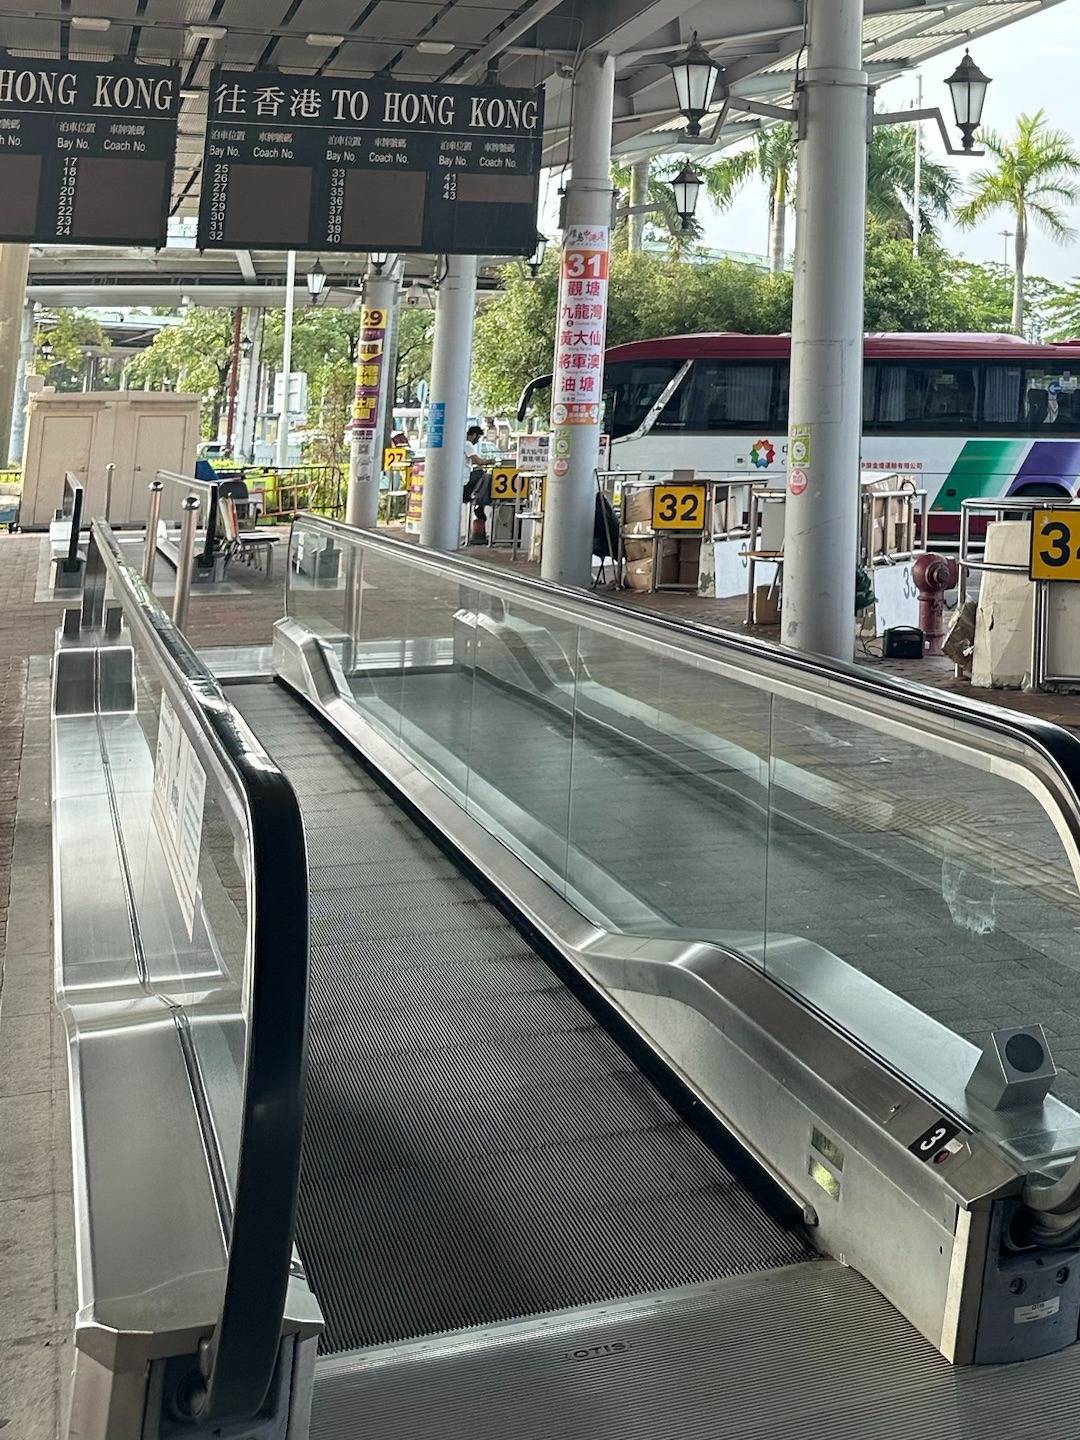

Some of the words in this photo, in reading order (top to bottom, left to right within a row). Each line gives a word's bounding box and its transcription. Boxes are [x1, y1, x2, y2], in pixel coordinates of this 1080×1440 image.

[0, 69, 77, 105] HONG
[93, 75, 173, 110] KONG
[214, 83, 322, 118] 往香港
[331, 89, 369, 121] TO
[382, 92, 455, 125] HONG
[469, 97, 539, 129] KONG
[8, 135, 22, 147] No.
[57, 137, 73, 150] Bay
[76, 138, 90, 149] No.
[104, 139, 130, 151] Coach
[133, 141, 147, 152] No.
[209, 145, 224, 158] Bay
[227, 146, 240, 157] No.
[253, 147, 279, 158] Coach
[281, 148, 295, 159] No.
[326, 150, 341, 163] Bay
[343, 151, 356, 162] No.
[368, 152, 393, 163] Coach
[396, 153, 409, 164] No.
[439, 155, 454, 167] Bay
[455, 155, 468, 166] No.
[64, 157, 78, 166] 17
[479, 157, 503, 168] Coach
[505, 158, 518, 168] No.
[63, 167, 77, 176] 18
[214, 164, 229, 173] 25
[214, 174, 228, 182] 26
[332, 169, 346, 178] 33
[443, 173, 456, 181] 41
[62, 177, 76, 186] 19
[331, 178, 344, 187] 34
[213, 183, 227, 192] 27
[443, 182, 457, 191] 42
[60, 187, 75, 196] 20
[330, 187, 344, 196] 35
[442, 191, 456, 200] 43
[59, 197, 73, 205] 21
[212, 193, 226, 201] 28
[330, 197, 343, 205] 36
[58, 207, 73, 215] 22
[211, 202, 226, 211] 29
[329, 206, 342, 215] 37
[57, 216, 72, 225] 23
[211, 212, 225, 221] 30
[328, 215, 342, 224] 38
[56, 226, 70, 235] 24
[210, 222, 223, 230] 31
[327, 225, 341, 233] 39
[209, 231, 223, 240] 32
[326, 234, 341, 243] 40
[567, 253, 601, 277] 31
[568, 280, 600, 296] 觀塘
[562, 303, 603, 320] 九龍灣
[560, 330, 601, 346] 黃大仙
[560, 353, 600, 369] 將軍澳
[561, 376, 594, 392] 油塘
[495, 474, 525, 494] 30
[658, 493, 698, 522] 32
[920, 1127, 947, 1152] 3
[573, 1342, 626, 1358] OTIS
